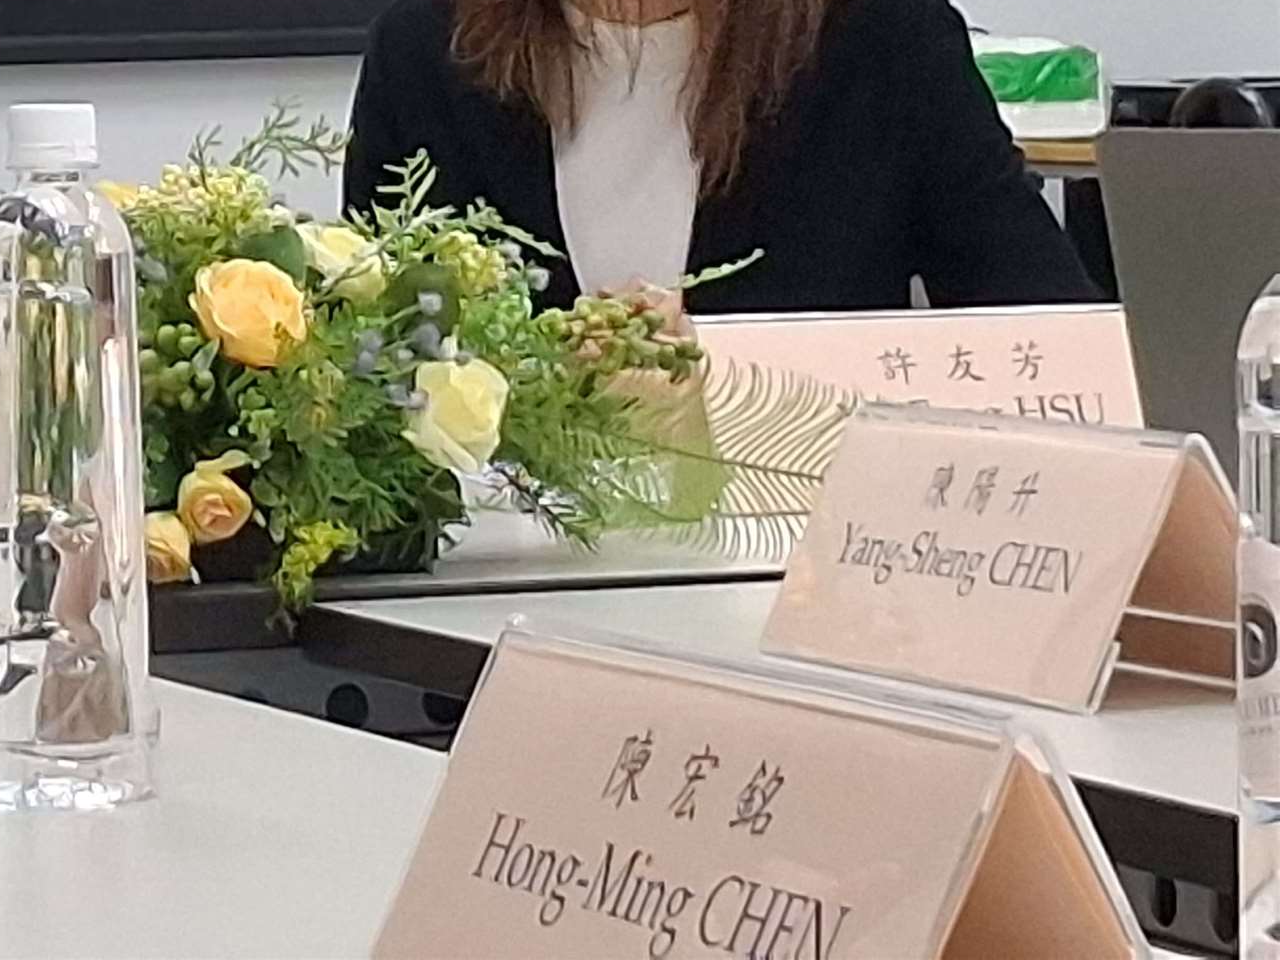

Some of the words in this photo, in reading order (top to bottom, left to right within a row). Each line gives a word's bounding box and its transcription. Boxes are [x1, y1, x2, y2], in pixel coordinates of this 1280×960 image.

[877, 340, 1043, 385] 許友芳
[1014, 392, 1104, 426] HSU
[837, 521, 985, 597] Yang-Sheng
[988, 540, 1083, 595] CHEN
[603, 730, 785, 836] 陳宏銘
[471, 812, 696, 960] Hong-Ming
[698, 874, 852, 960] CHEN
